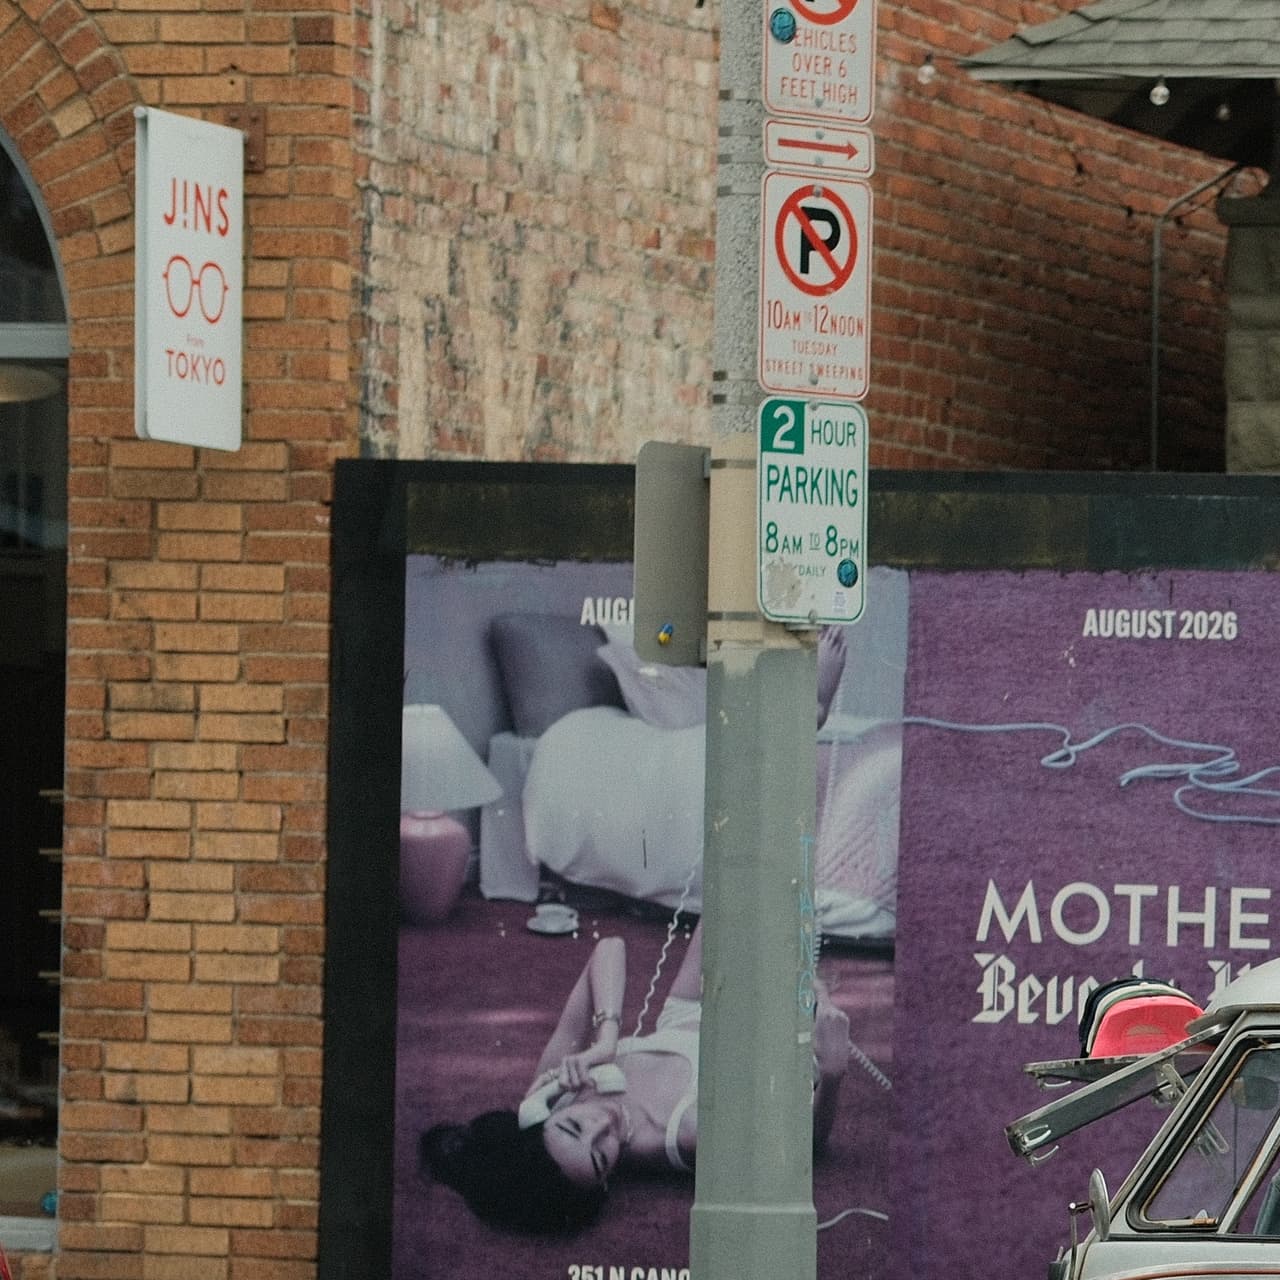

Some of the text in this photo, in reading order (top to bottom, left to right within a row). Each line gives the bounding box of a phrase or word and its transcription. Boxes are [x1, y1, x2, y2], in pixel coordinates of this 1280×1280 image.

[795, 27, 857, 54] EHICLES
[792, 52, 847, 78] OVER 6
[781, 76, 857, 106] FEET HIGH
[766, 300, 801, 330] 10AM
[793, 340, 838, 356] TUESDAY
[165, 349, 225, 385] TOKYO
[766, 359, 863, 381] STREET SWEEPING
[772, 405, 856, 450] 2 HOUR
[766, 464, 858, 508] PARKING
[766, 521, 859, 558] 8AM TO 8PM
[799, 564, 826, 577] DAILY
[581, 597, 634, 626] AUG
[1083, 609, 1238, 640] AUGUST 2026
